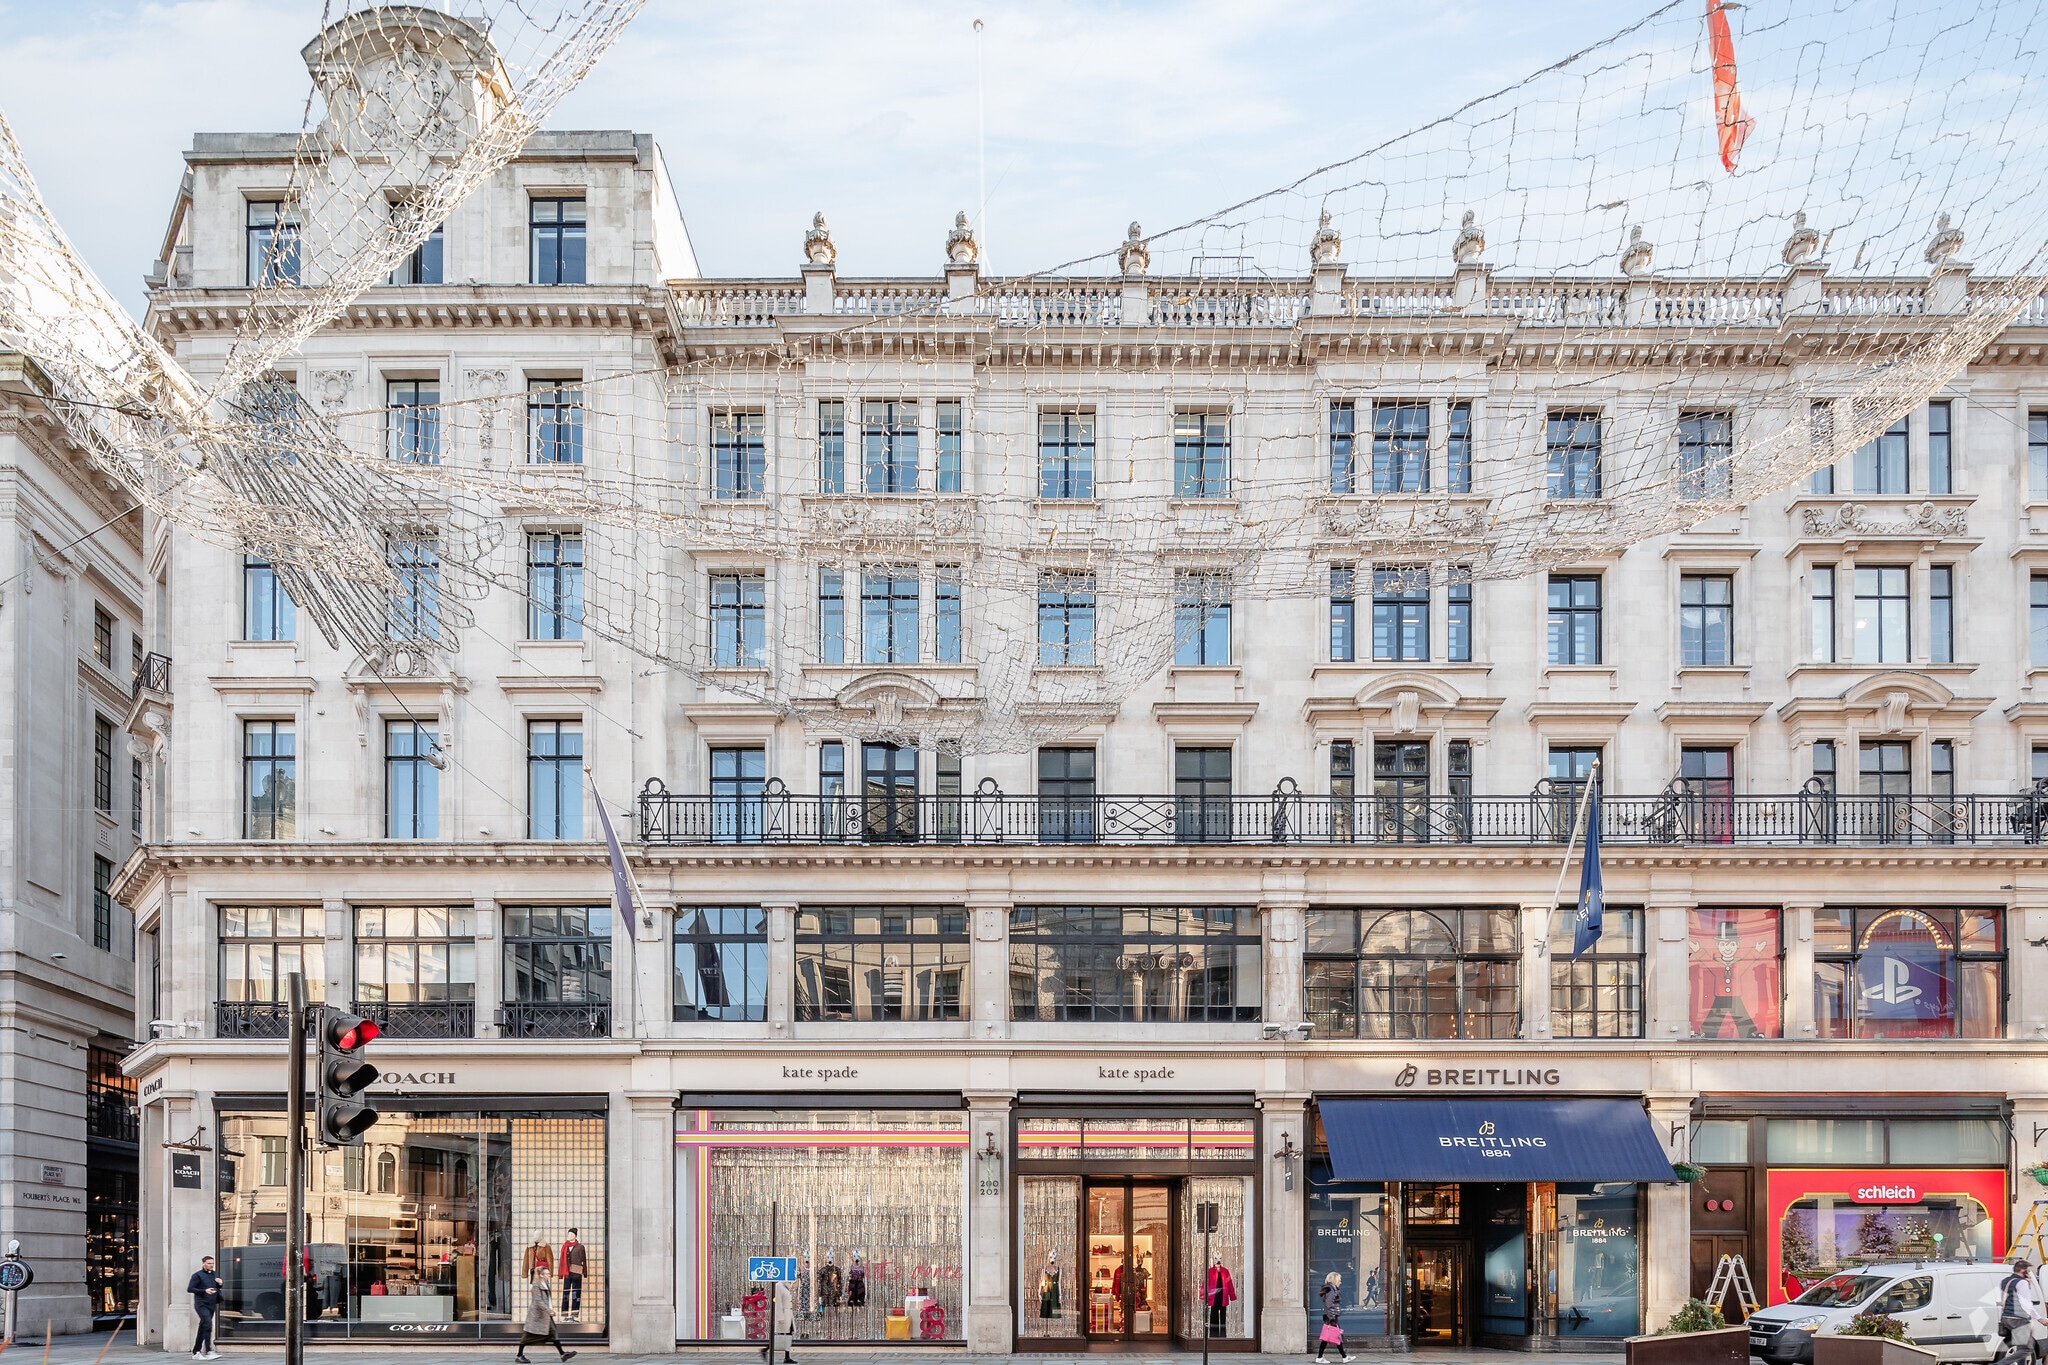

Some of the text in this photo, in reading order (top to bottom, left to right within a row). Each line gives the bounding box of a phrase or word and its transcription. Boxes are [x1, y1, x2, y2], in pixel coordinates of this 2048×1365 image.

[782, 1065, 858, 1082] kate spade
[1099, 1065, 1174, 1083] kate spade
[1427, 1069, 1560, 1085] BREITLING
[144, 1077, 162, 1097] COACH
[1439, 1137, 1547, 1148] BREITLING
[1481, 1149, 1511, 1158] 1884
[23, 1192, 51, 1201] FOUBERT'S
[52, 1195, 70, 1203] PLACE
[1857, 1185, 1916, 1199] schleich
[1573, 1229, 1626, 1237] BREITLING
[911, 1259, 963, 1281] dance
